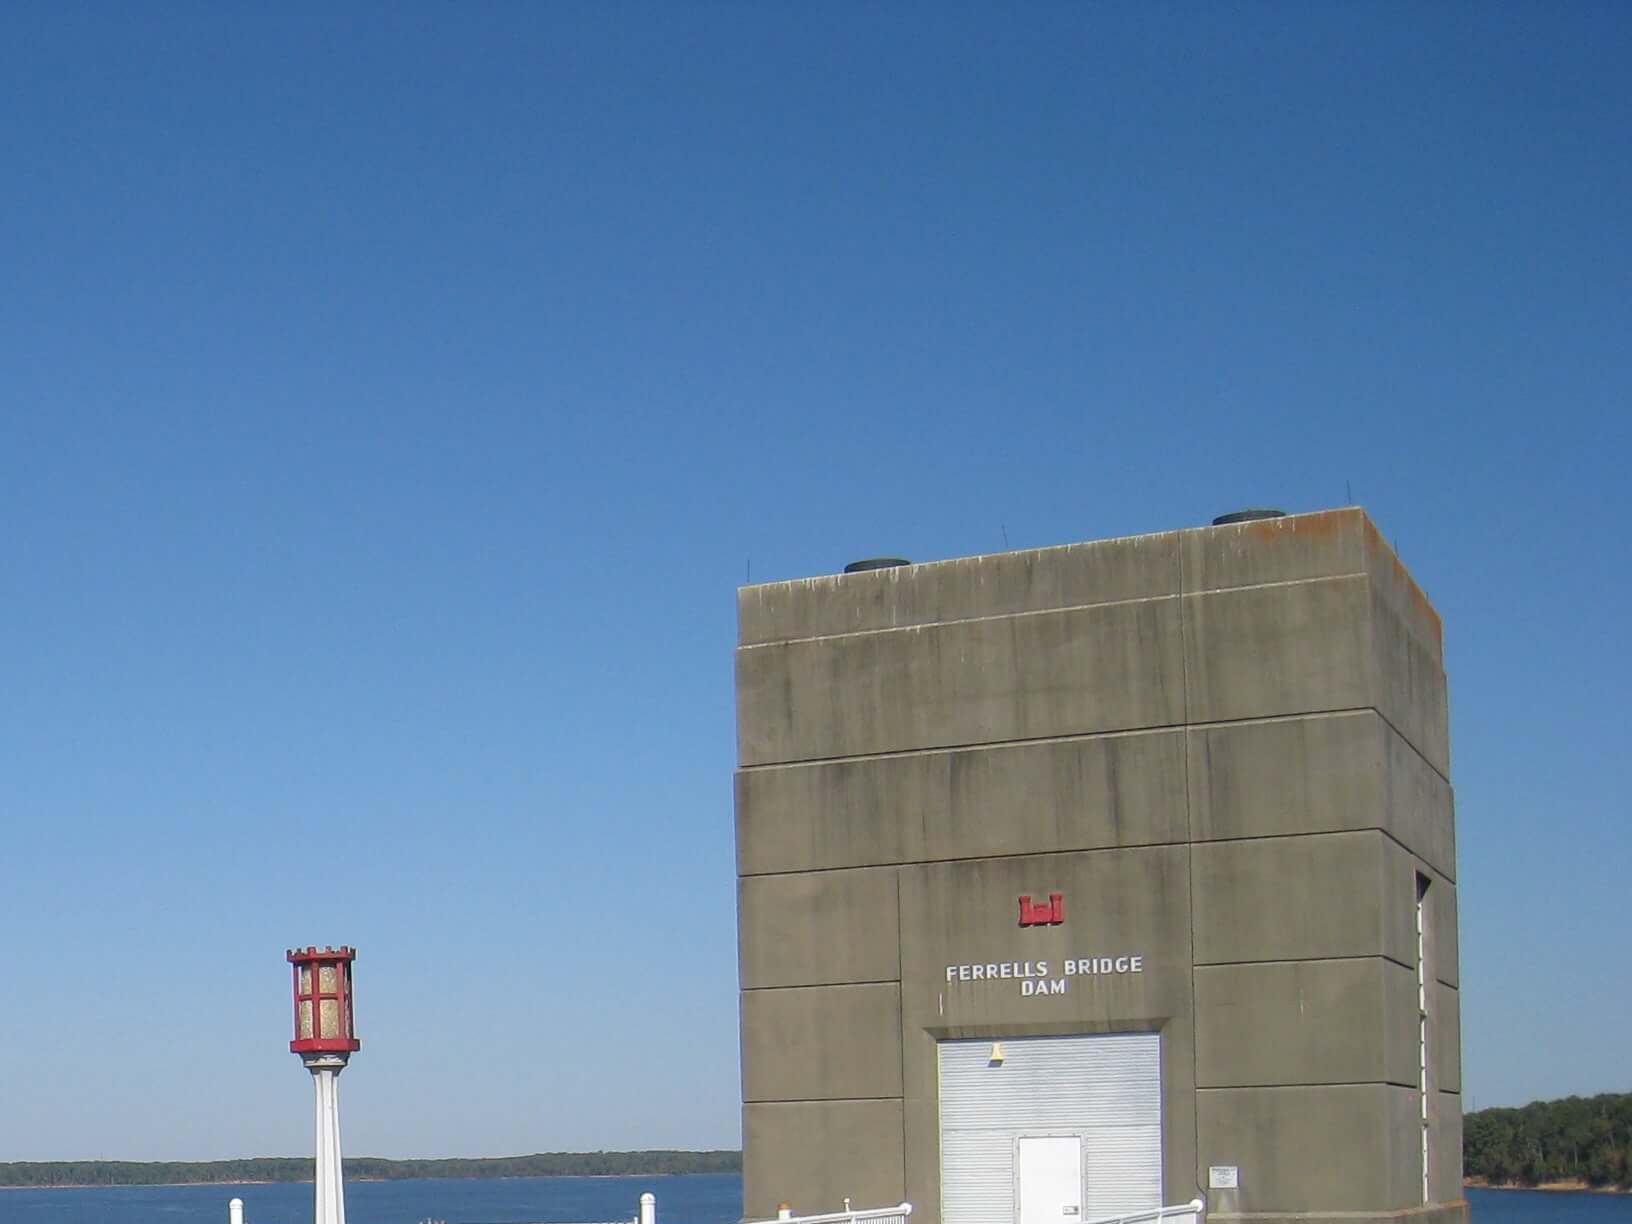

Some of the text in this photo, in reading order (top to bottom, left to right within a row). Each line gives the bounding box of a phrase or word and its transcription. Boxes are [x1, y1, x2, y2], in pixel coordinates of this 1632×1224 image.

[946, 956, 1143, 982] FERRELLS BRIDGE
[1021, 979, 1066, 997] DAM
